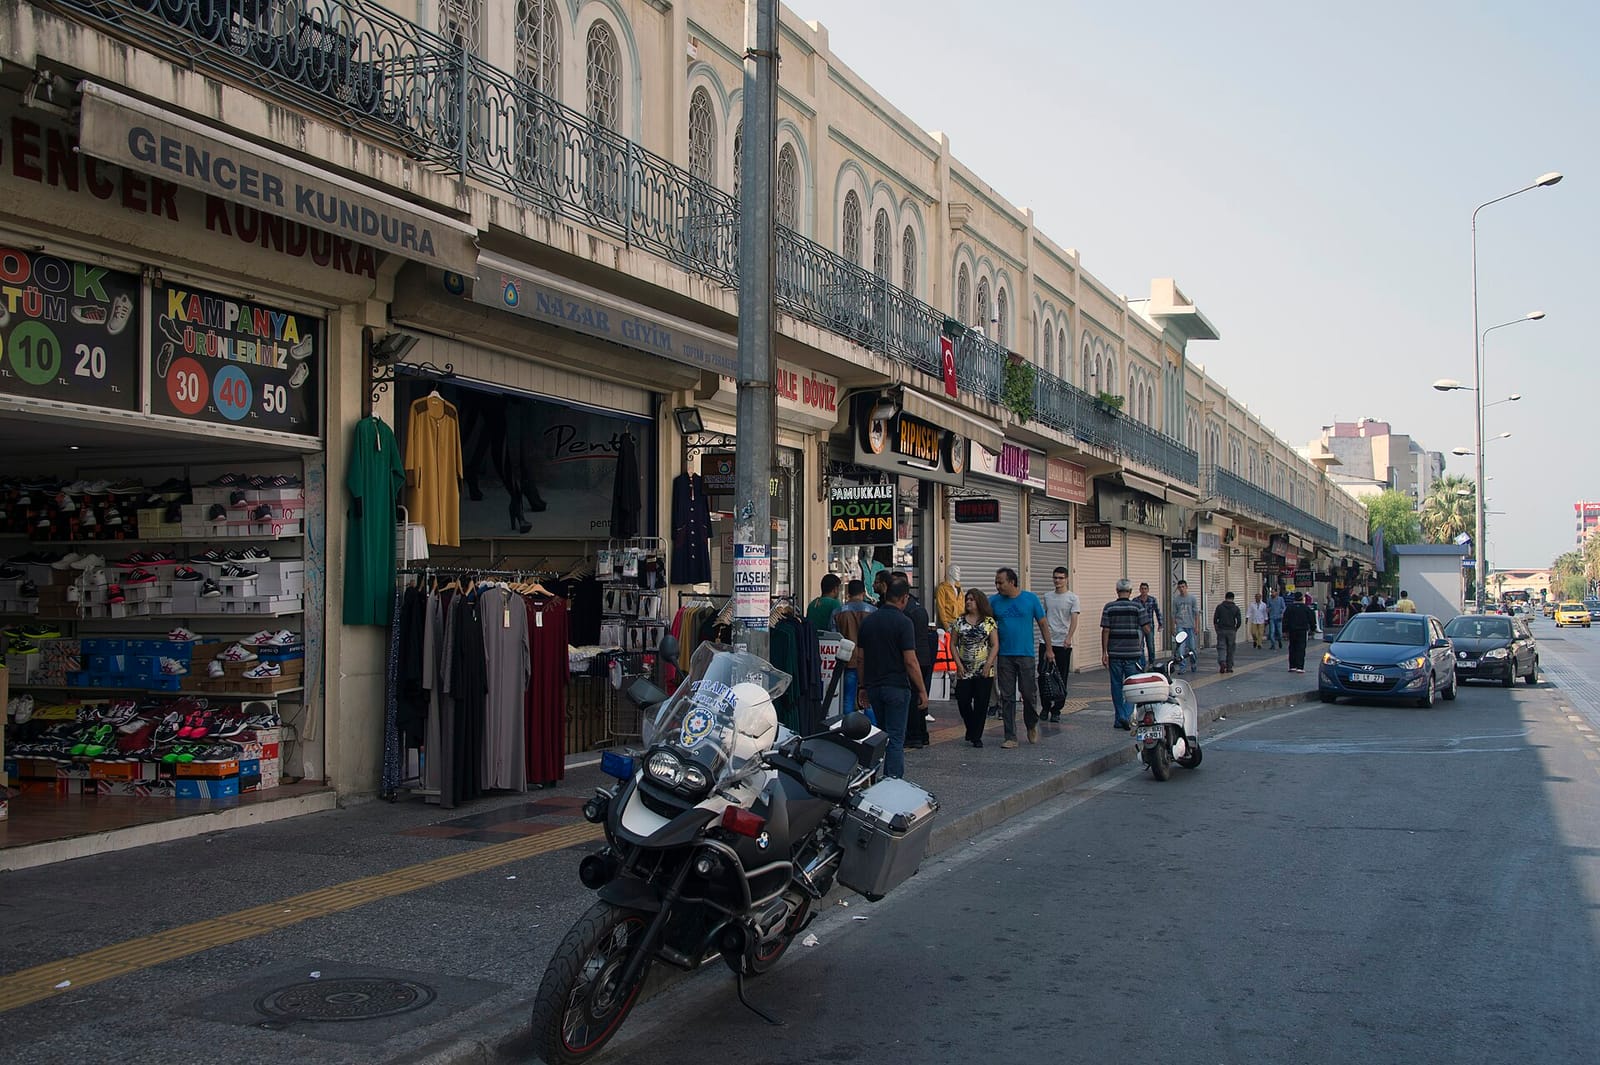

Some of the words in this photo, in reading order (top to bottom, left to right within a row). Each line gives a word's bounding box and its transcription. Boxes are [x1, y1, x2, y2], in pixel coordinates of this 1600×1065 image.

[0, 117, 179, 222] ENCER
[129, 127, 284, 207] GENCER
[295, 184, 436, 257] KUNDURA
[2, 285, 67, 322] TÜM
[168, 289, 299, 344] KAMPANYA
[536, 291, 610, 333] NAZAR
[621, 317, 673, 350] GİYİM
[19, 335, 53, 371] 10
[75, 343, 107, 379] 20
[184, 326, 288, 370] ÜRÜNLERİMİZ
[176, 371, 199, 402] 30
[220, 377, 247, 408] 40
[263, 383, 287, 414] 50
[777, 368, 798, 401] ALE
[802, 372, 836, 412] DÖVİZ
[544, 424, 635, 457] Pent
[831, 486, 892, 501] PAMUKKALE
[832, 500, 892, 516] DÖVİZ
[833, 517, 892, 532] ALTIN
[744, 545, 765, 554] Zirve
